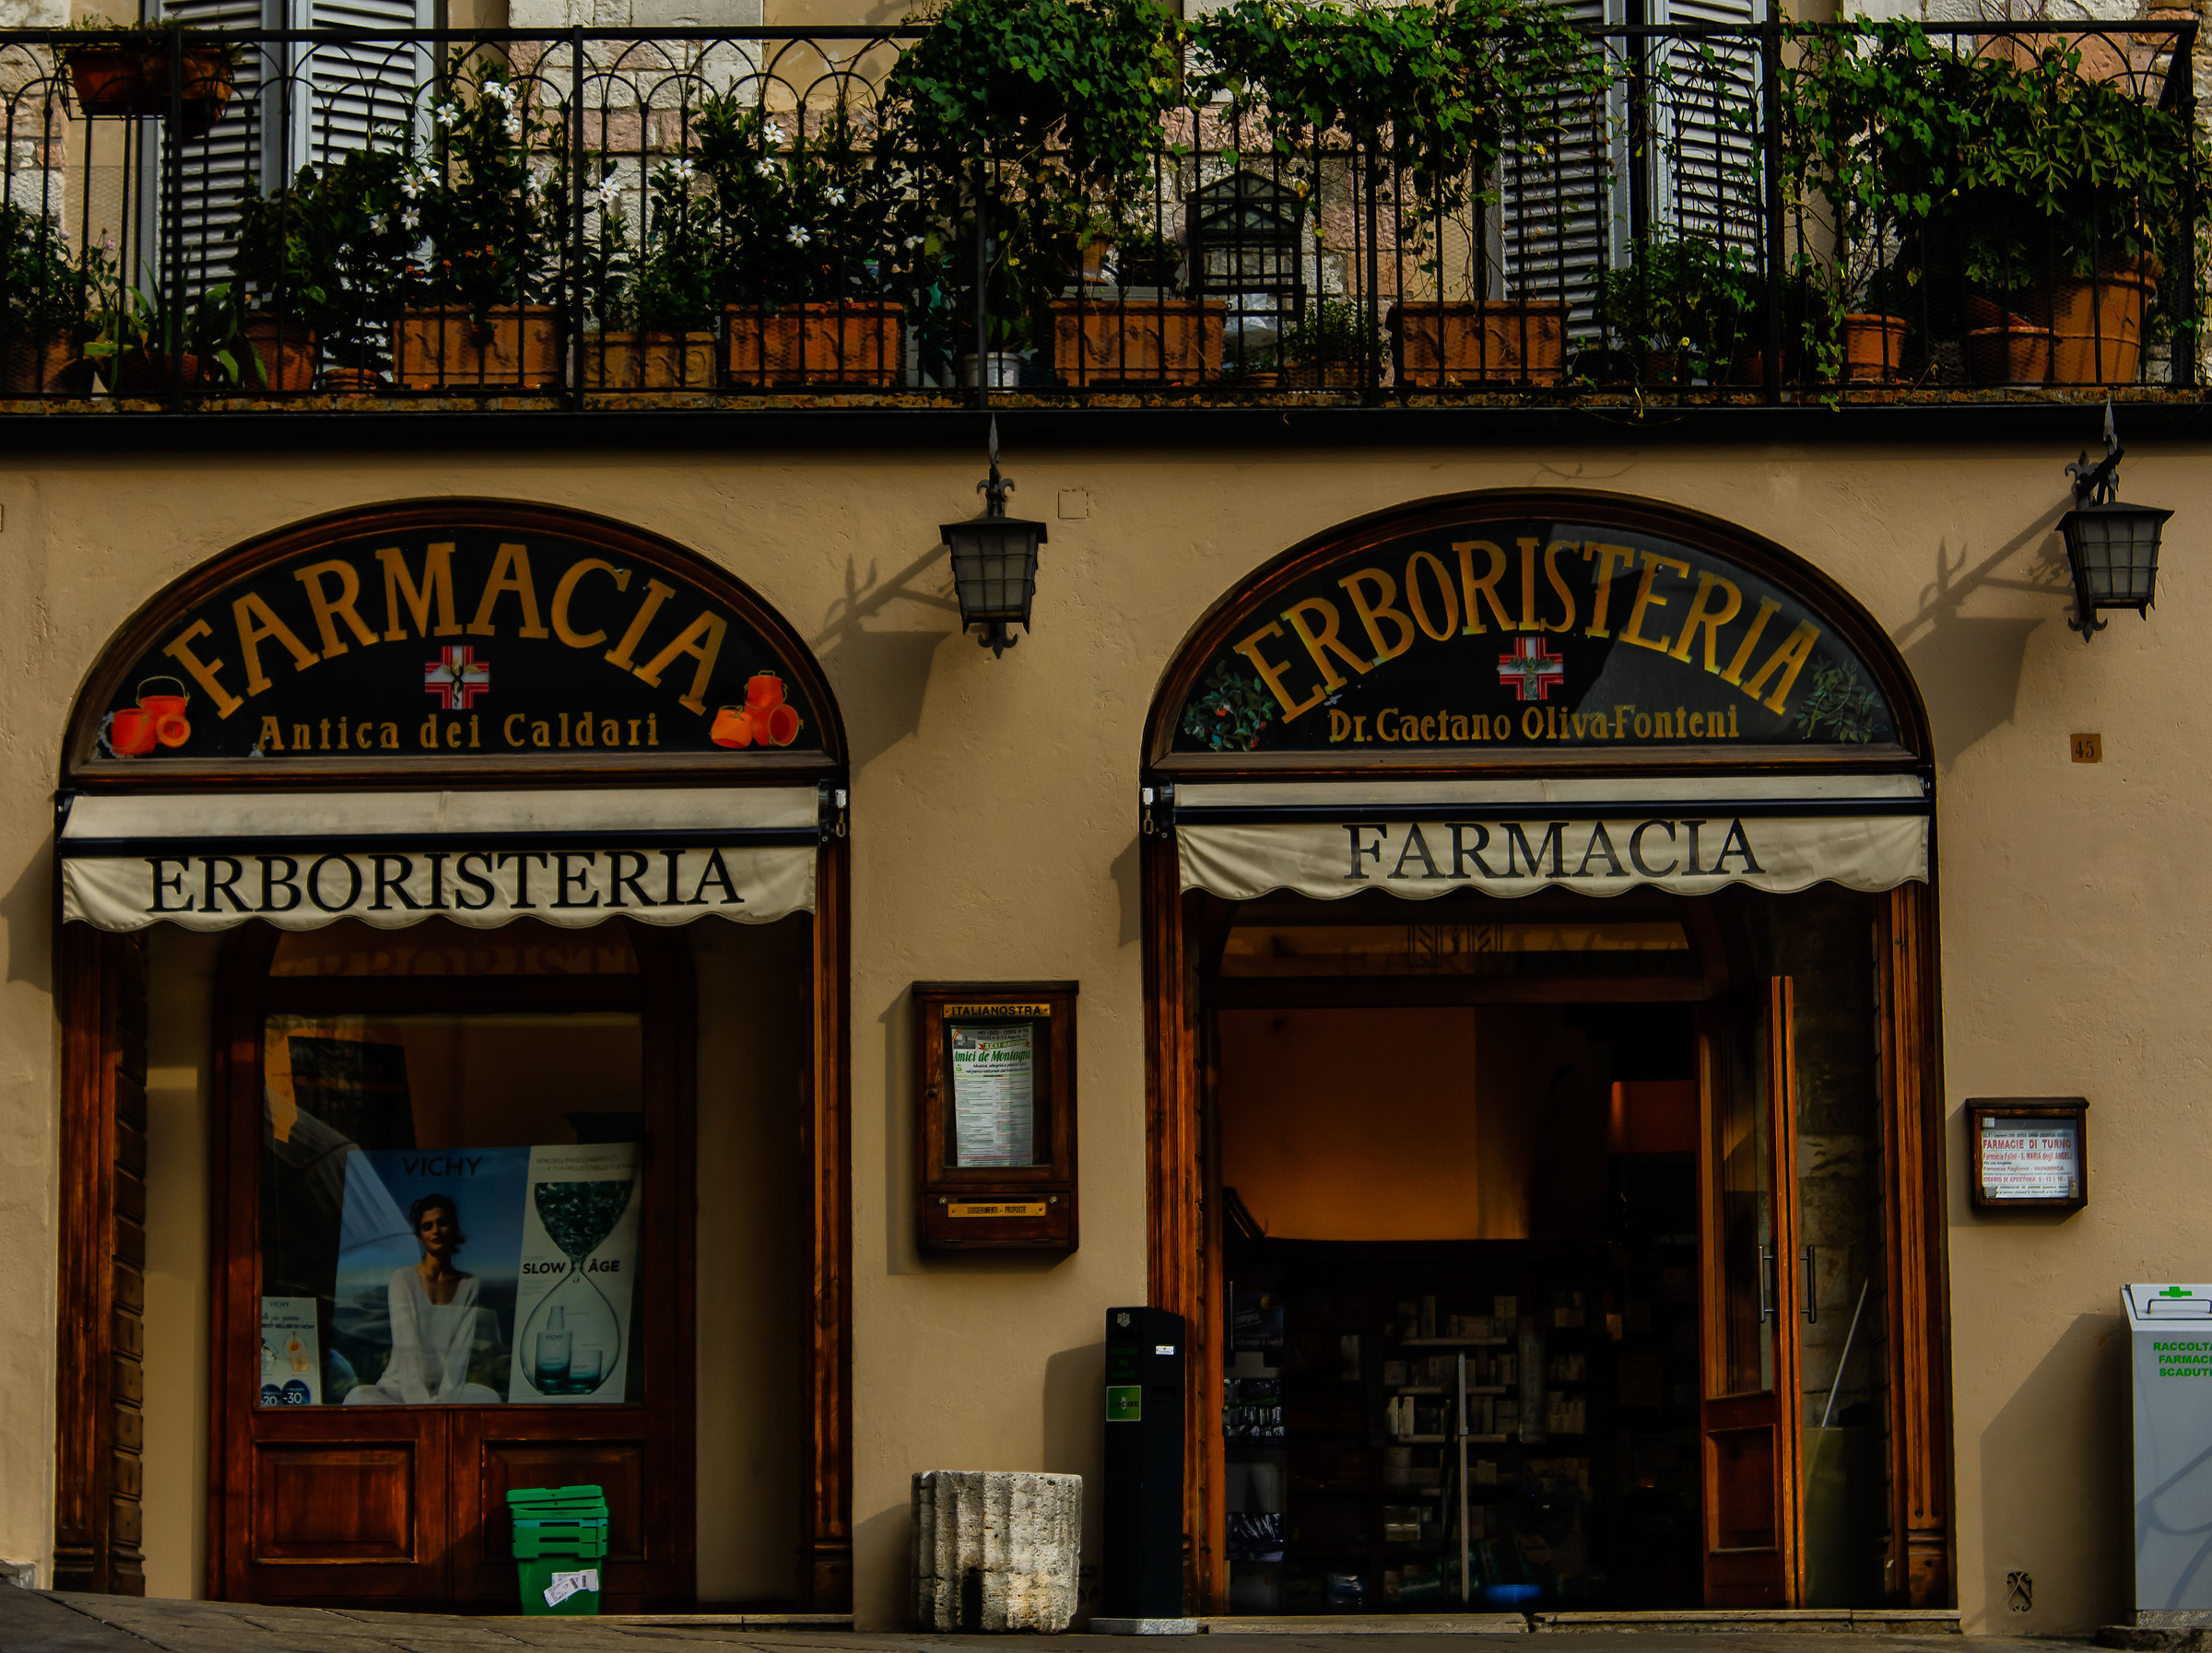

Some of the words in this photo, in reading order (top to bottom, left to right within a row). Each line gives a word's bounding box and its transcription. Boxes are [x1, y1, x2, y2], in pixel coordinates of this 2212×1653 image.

[163, 542, 728, 719] FARMACIA
[1233, 537, 1823, 725] ERBORISTERIA
[259, 715, 400, 751] Antica
[420, 714, 481, 748] dei
[504, 712, 659, 747] Caldari
[2075, 741, 2095, 759] 45
[1341, 817, 1767, 880] FARMACIA
[145, 847, 745, 914] ERBORISTERIA
[951, 1005, 1041, 1015] ITALIANOSTRA
[954, 1050, 976, 1062] Amici
[978, 1050, 990, 1062] de
[1983, 1139, 2025, 1149] FARMACIE
[2029, 1139, 2038, 1149] DI
[2041, 1139, 2072, 1149] TURNO
[403, 1156, 483, 1177] VICHY
[523, 1262, 566, 1274] SLOW
[588, 1259, 620, 1272] ÂGE
